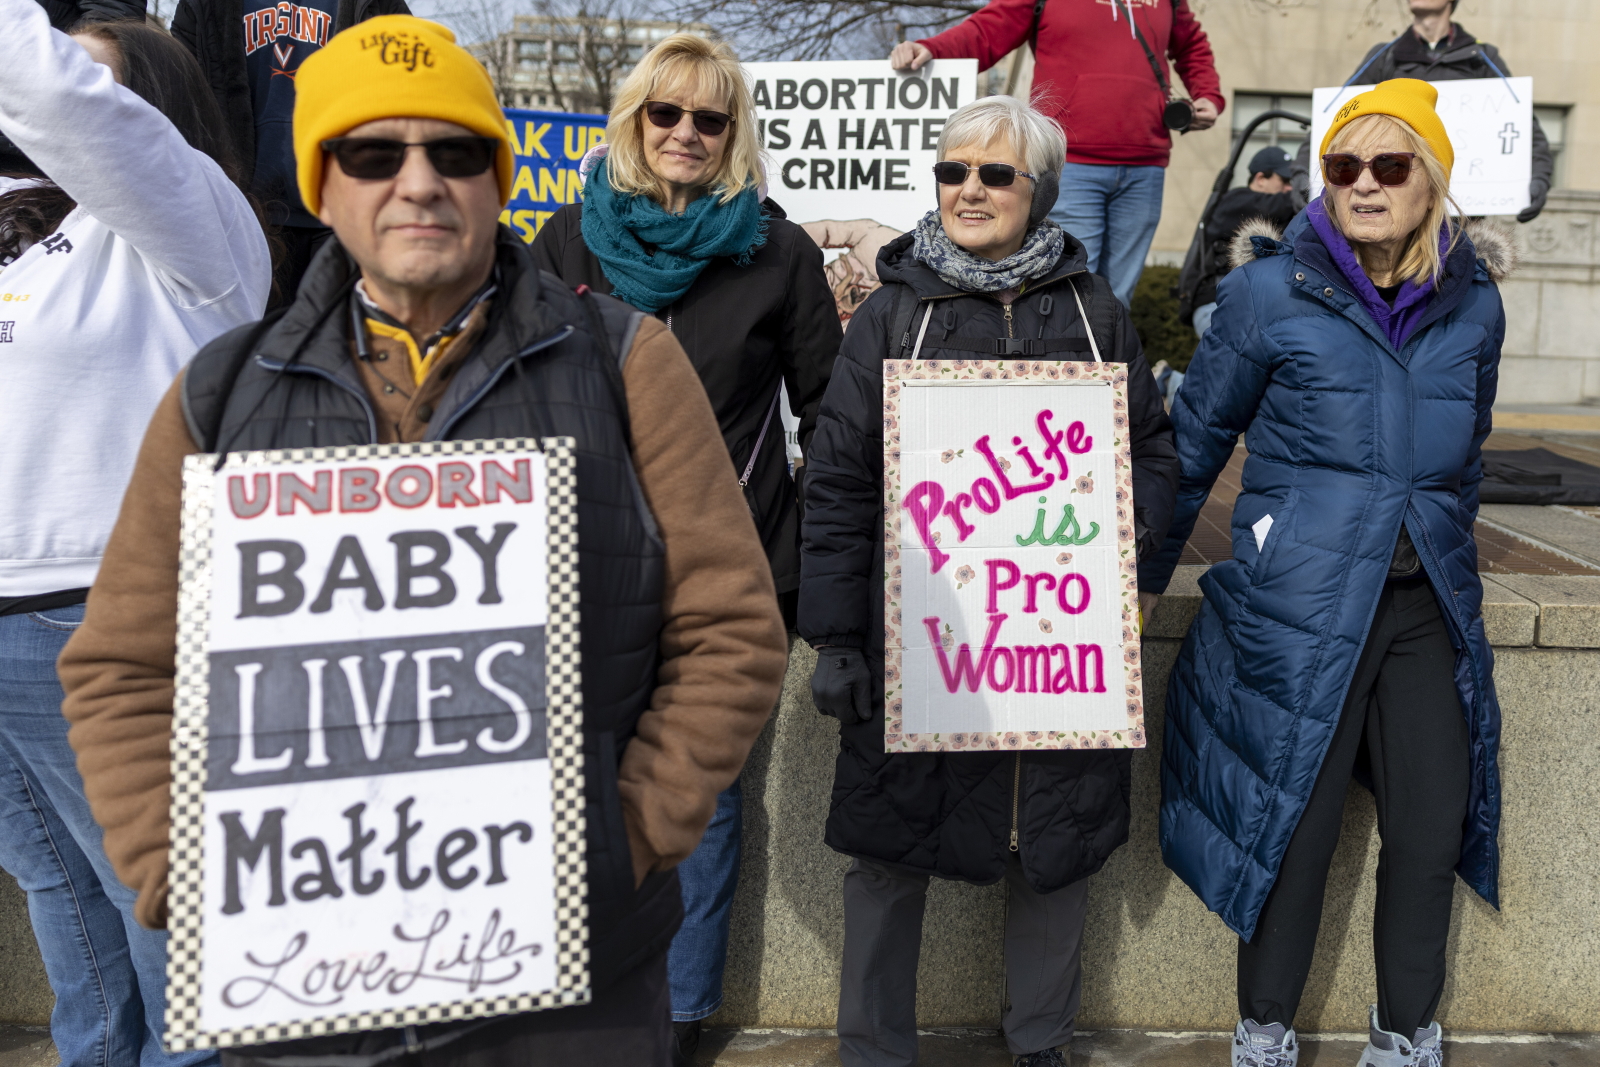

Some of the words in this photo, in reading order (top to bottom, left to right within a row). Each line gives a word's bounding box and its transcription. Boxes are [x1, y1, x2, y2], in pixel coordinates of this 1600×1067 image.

[753, 76, 960, 111] ABORTION
[800, 118, 827, 150] A
[837, 118, 948, 151] HATE
[781, 156, 916, 191] CRIME.
[0, 293, 31, 302] 843
[227, 458, 533, 519] UNBORN
[1016, 495, 1100, 546] is
[235, 521, 518, 619] BABY
[983, 558, 1091, 615] Pro
[922, 612, 1107, 695] Woman
[230, 640, 532, 775] LIVES
[218, 796, 533, 916] Matter
